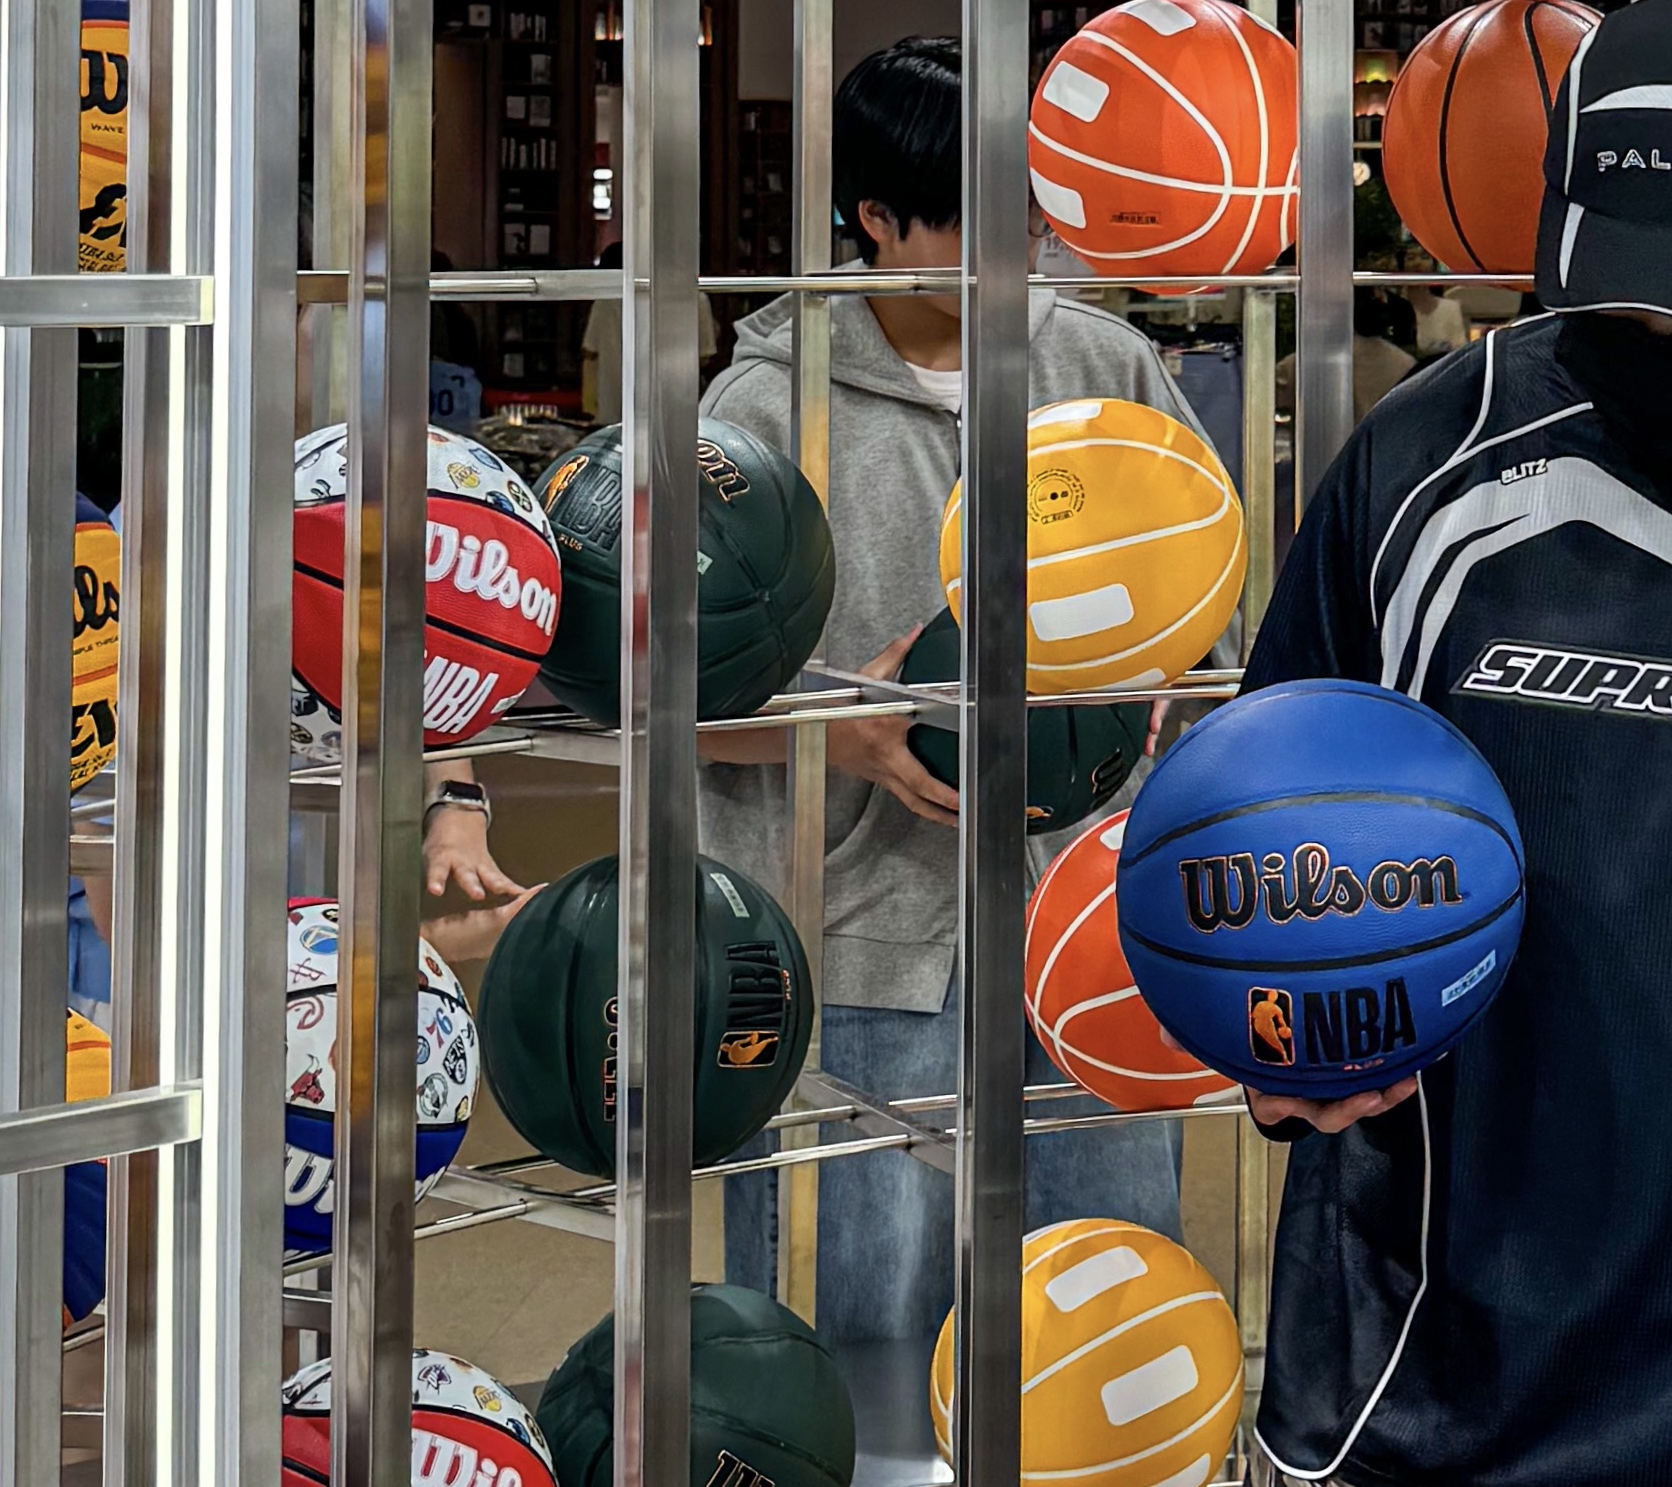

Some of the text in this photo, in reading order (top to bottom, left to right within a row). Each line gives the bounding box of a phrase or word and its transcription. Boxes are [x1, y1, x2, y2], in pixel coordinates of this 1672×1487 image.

[1501, 458, 1549, 486] BLITZ
[425, 524, 558, 637] Wilson
[424, 657, 499, 735] NBA
[1179, 843, 1464, 934] Wilson
[1303, 976, 1418, 1065] NBA
